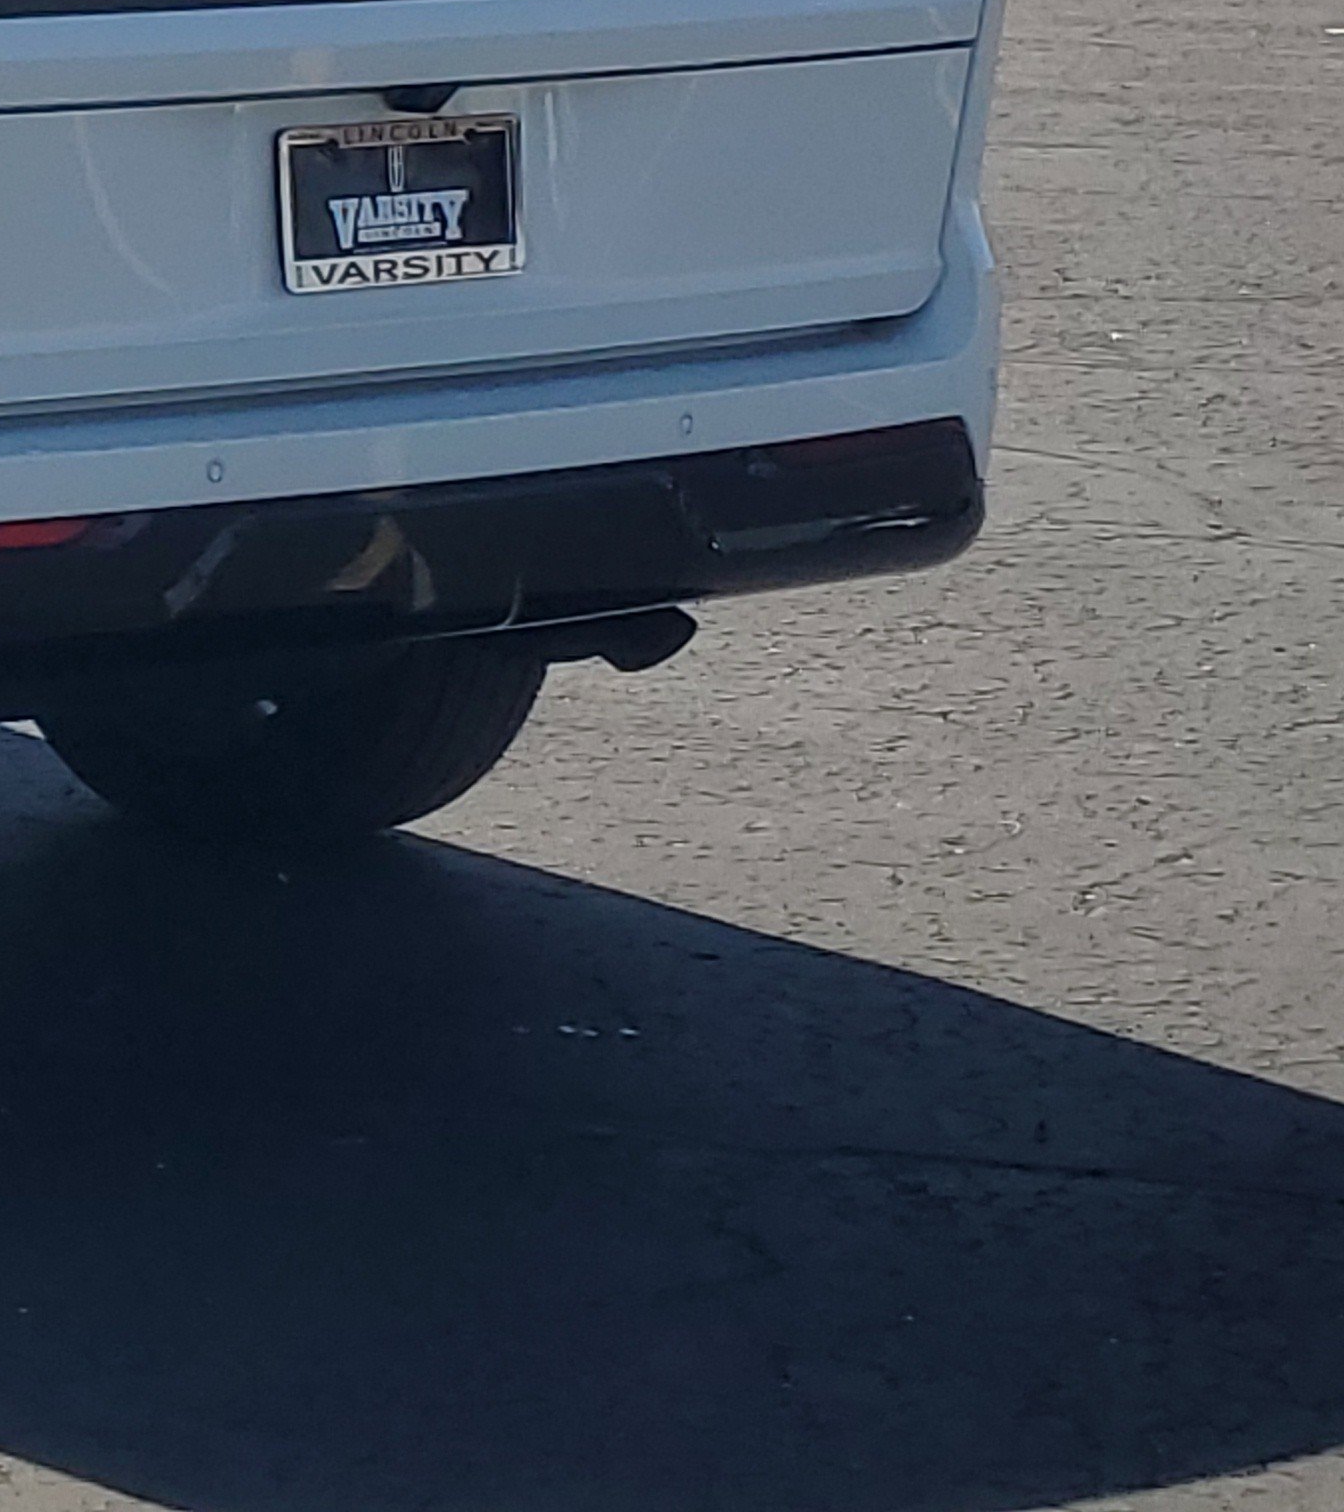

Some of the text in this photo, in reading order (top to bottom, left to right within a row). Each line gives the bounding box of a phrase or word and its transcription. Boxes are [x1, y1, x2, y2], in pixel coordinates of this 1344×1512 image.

[343, 122, 459, 144] LINCOLN
[328, 190, 469, 249] VARSITY
[312, 250, 500, 285] VARSITY
